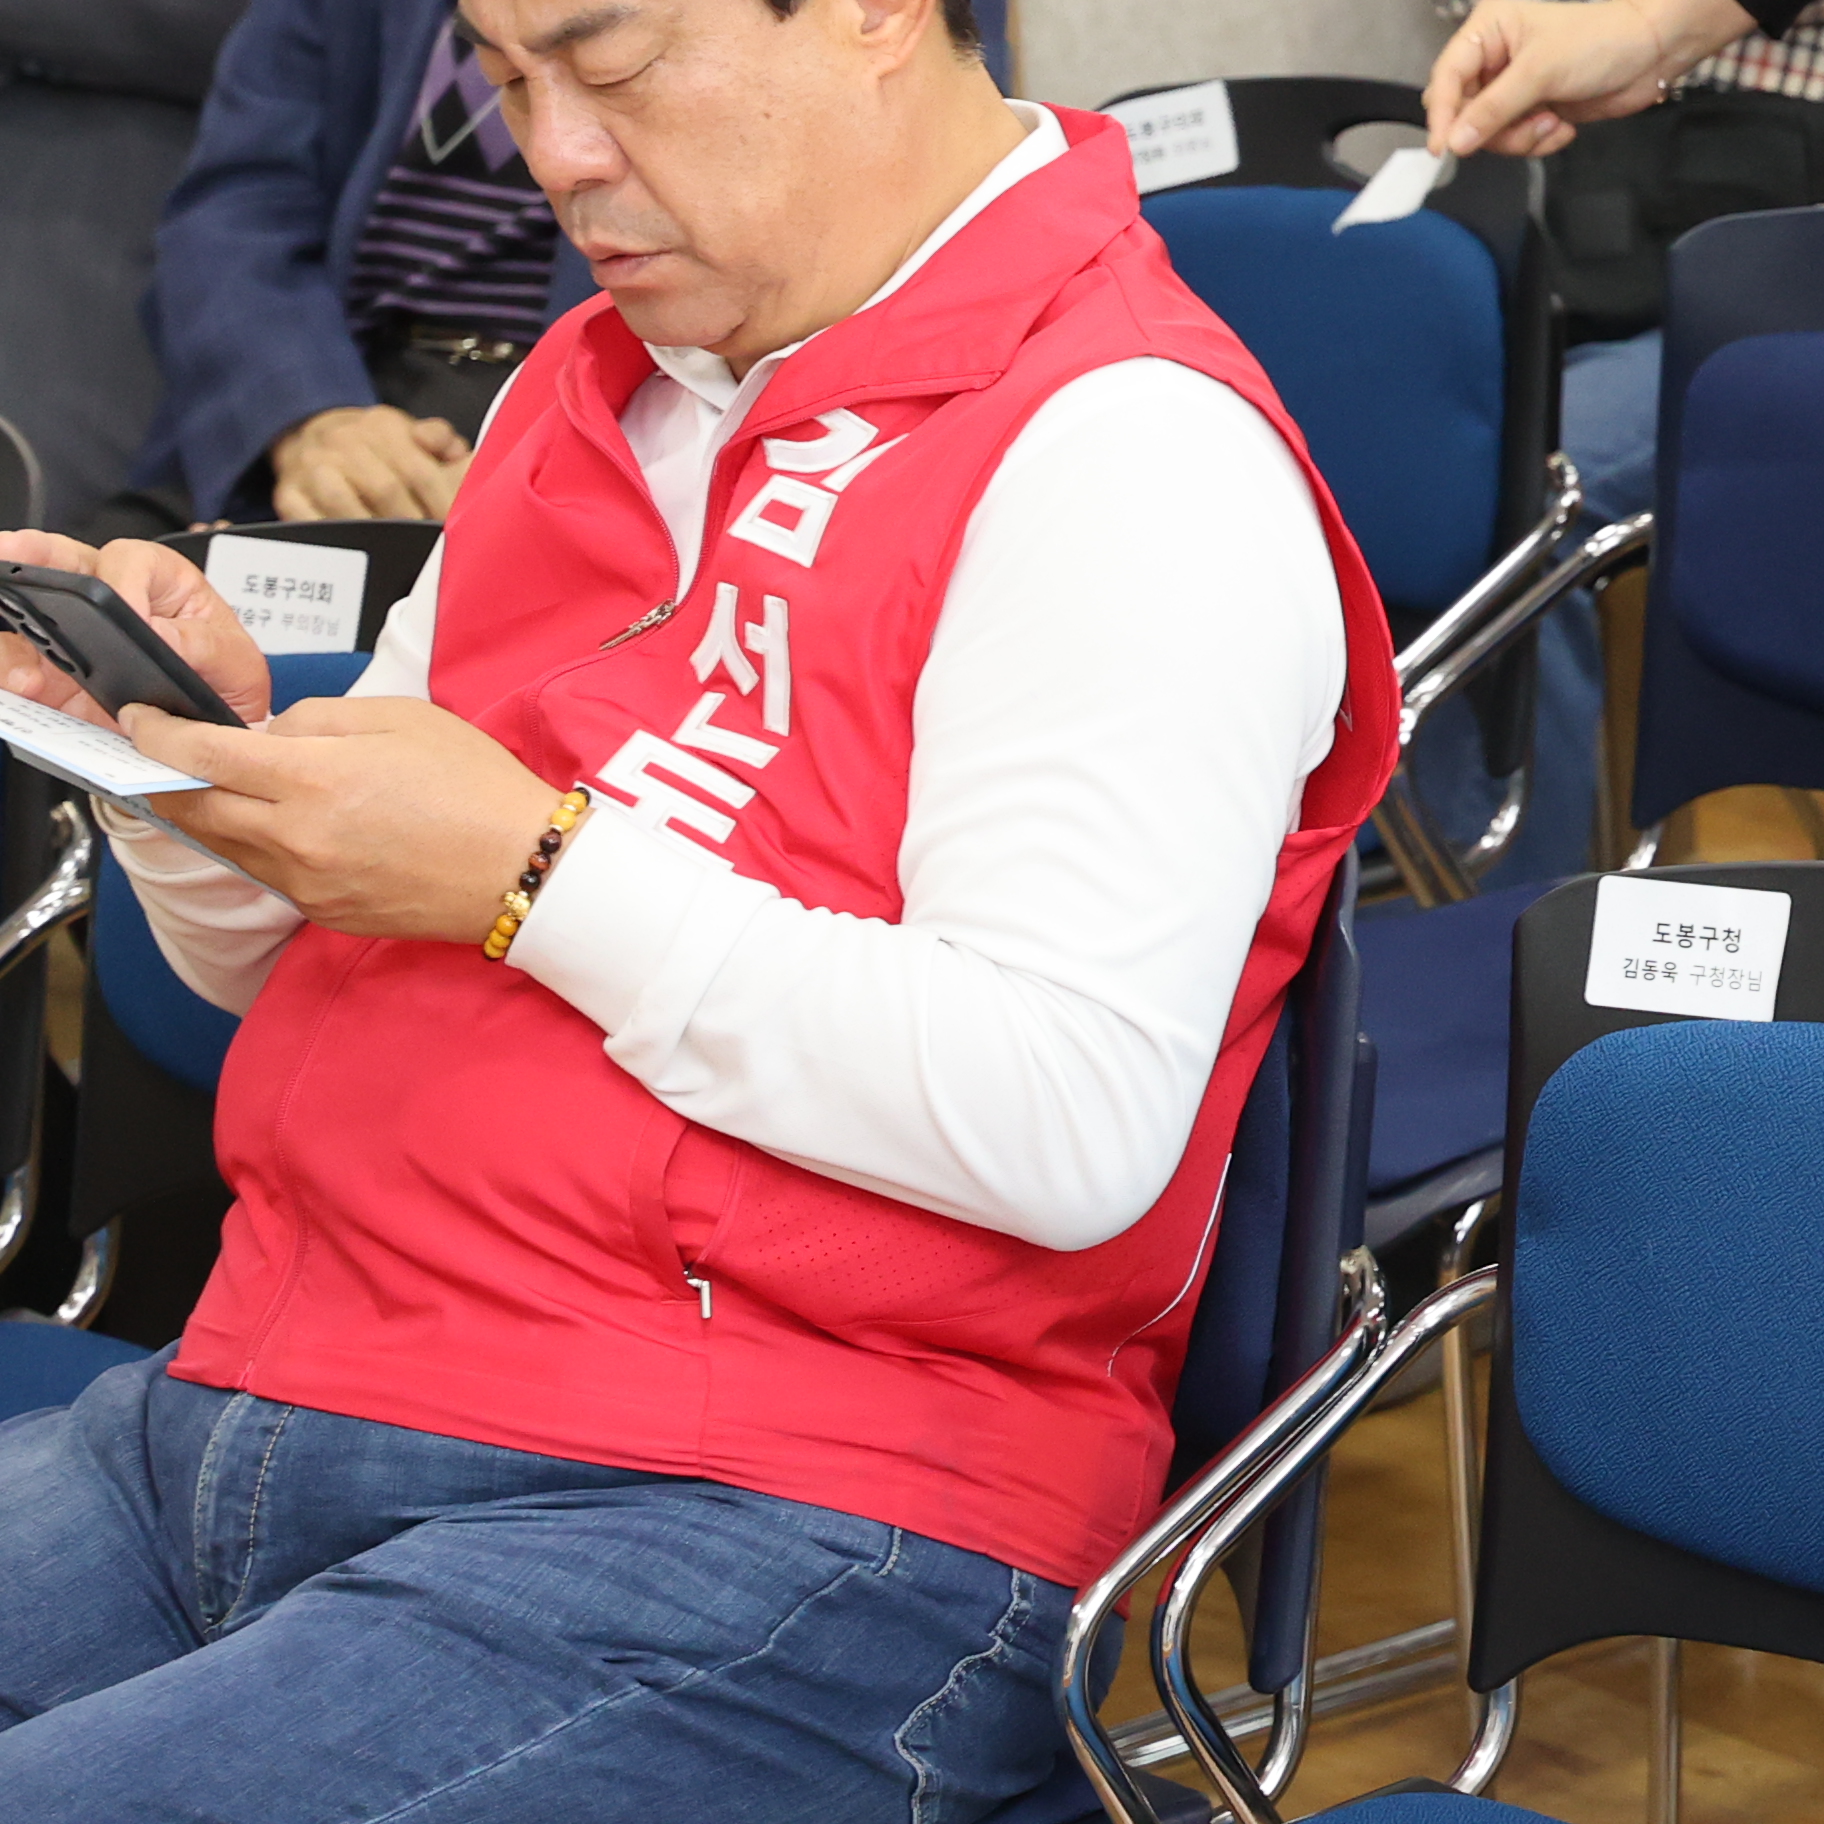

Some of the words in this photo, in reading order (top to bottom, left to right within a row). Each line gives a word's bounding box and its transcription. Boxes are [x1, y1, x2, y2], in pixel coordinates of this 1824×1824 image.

[241, 573, 334, 604] 도봉구의회
[1652, 922, 1743, 954] 도봉구청
[1622, 957, 1679, 984] 김동욱
[1688, 963, 1763, 993] 구청장님
